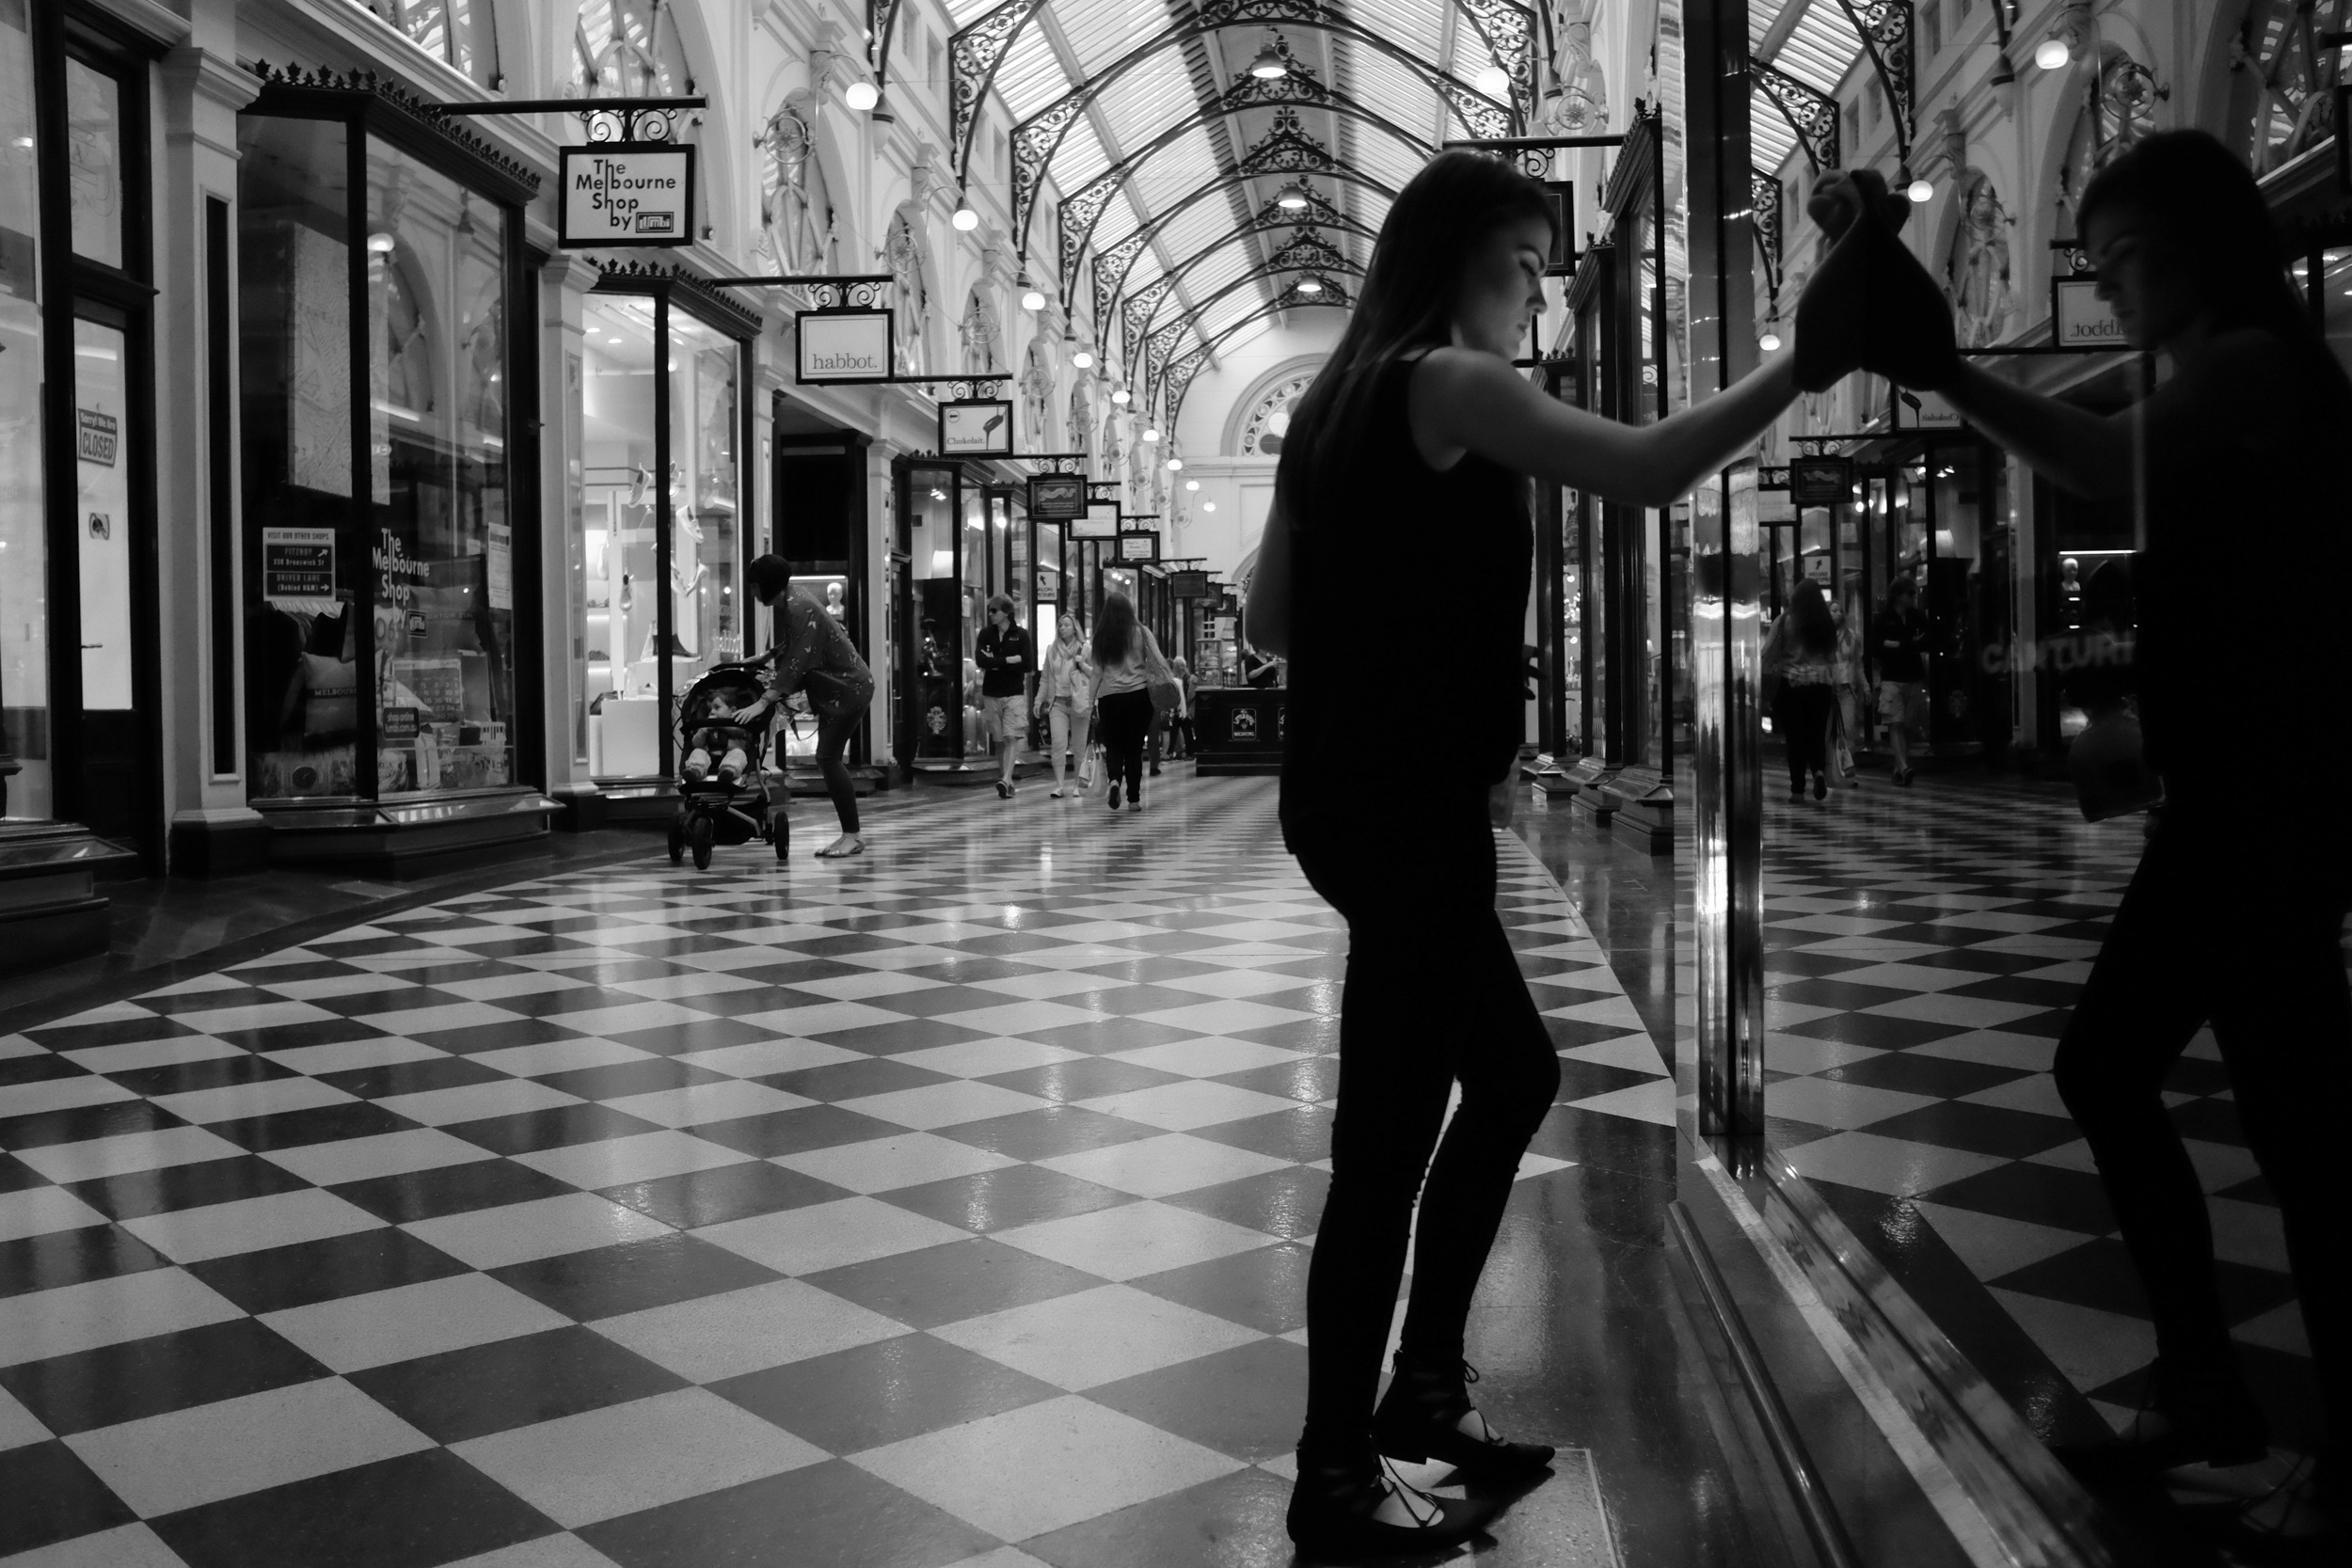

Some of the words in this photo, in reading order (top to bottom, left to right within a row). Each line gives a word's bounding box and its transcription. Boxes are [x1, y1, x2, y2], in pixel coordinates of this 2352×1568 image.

[594, 159, 626, 175] The
[576, 174, 676, 190] Melbourne
[592, 192, 639, 214] Shop
[610, 213, 632, 230] by
[812, 353, 878, 370] habbot.
[83, 432, 114, 460] CLOSED
[381, 528, 402, 552] The
[373, 546, 430, 577] Melbourne
[382, 574, 410, 606] Shop
[393, 607, 406, 629] by
